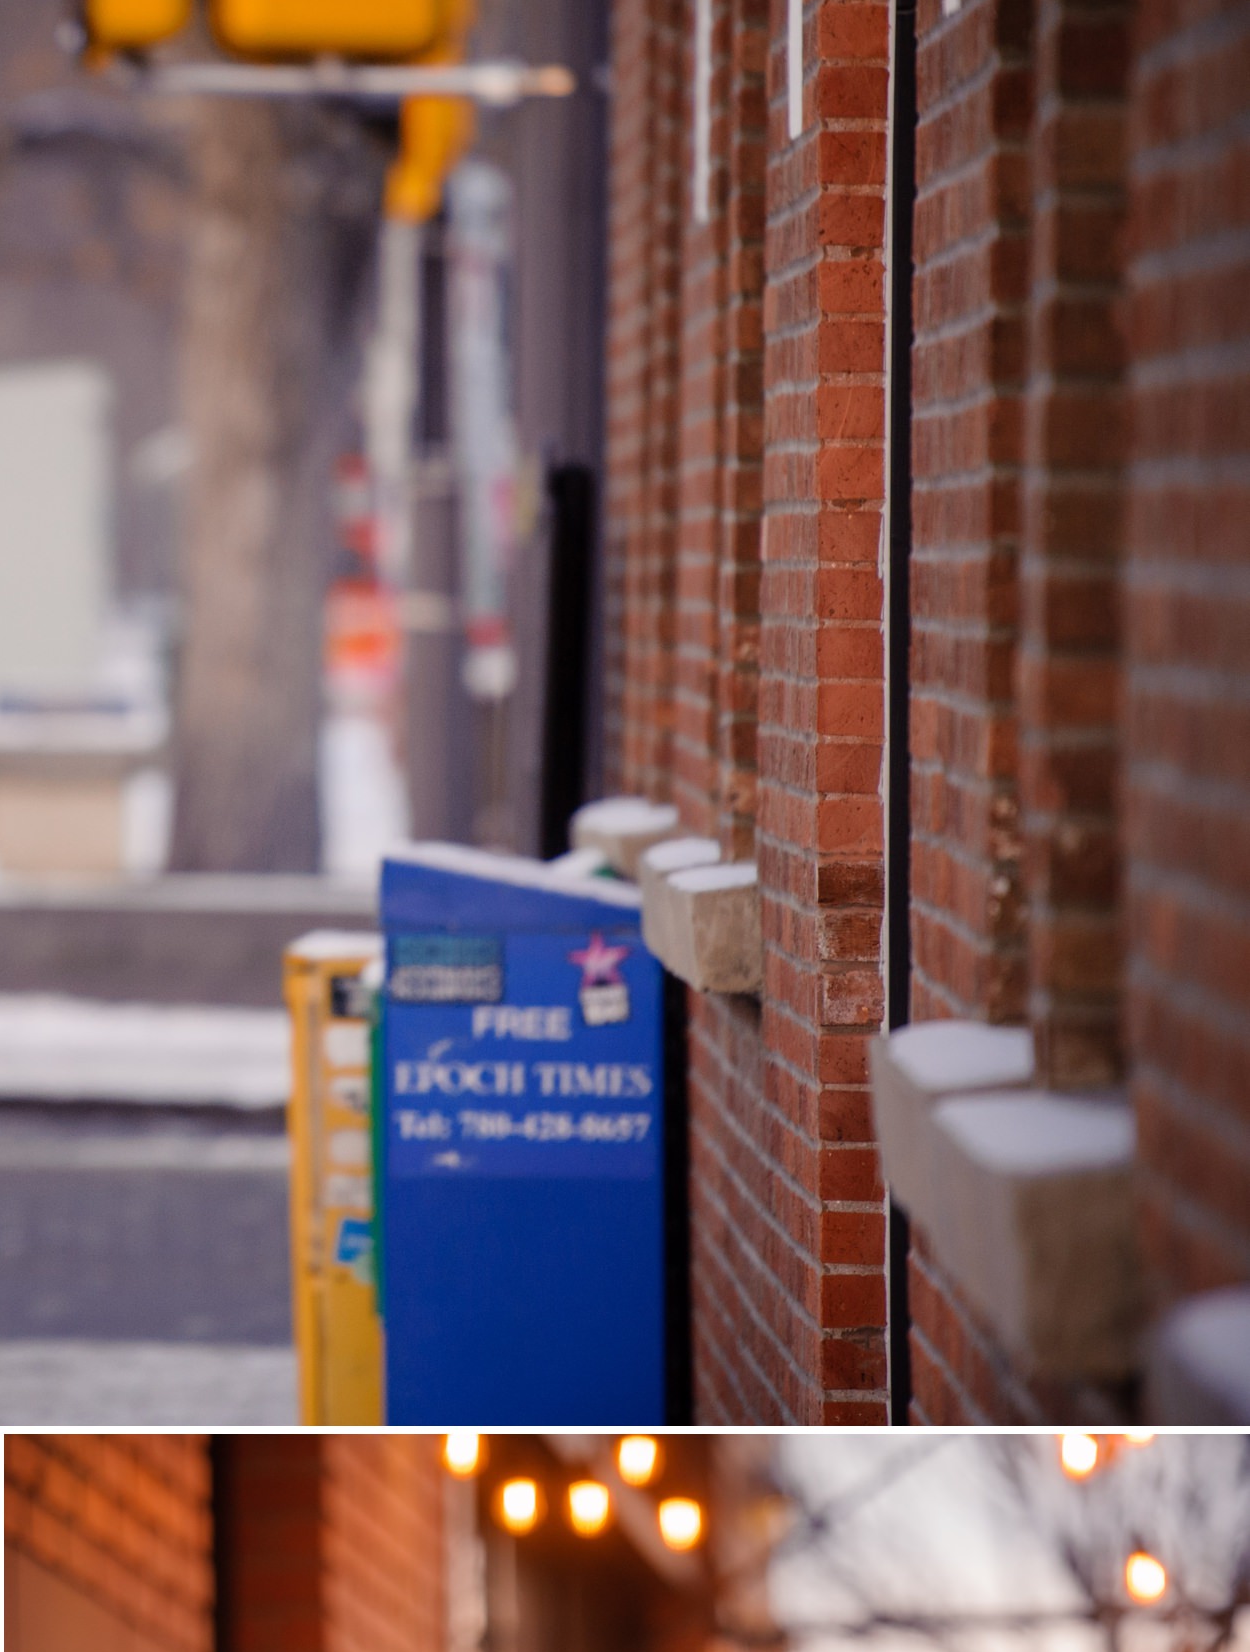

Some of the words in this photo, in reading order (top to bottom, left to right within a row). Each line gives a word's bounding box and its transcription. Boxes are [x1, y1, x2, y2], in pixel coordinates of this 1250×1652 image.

[471, 1005, 572, 1041] FREE
[394, 1061, 526, 1096] EPOCH
[532, 1062, 654, 1098] TIMES
